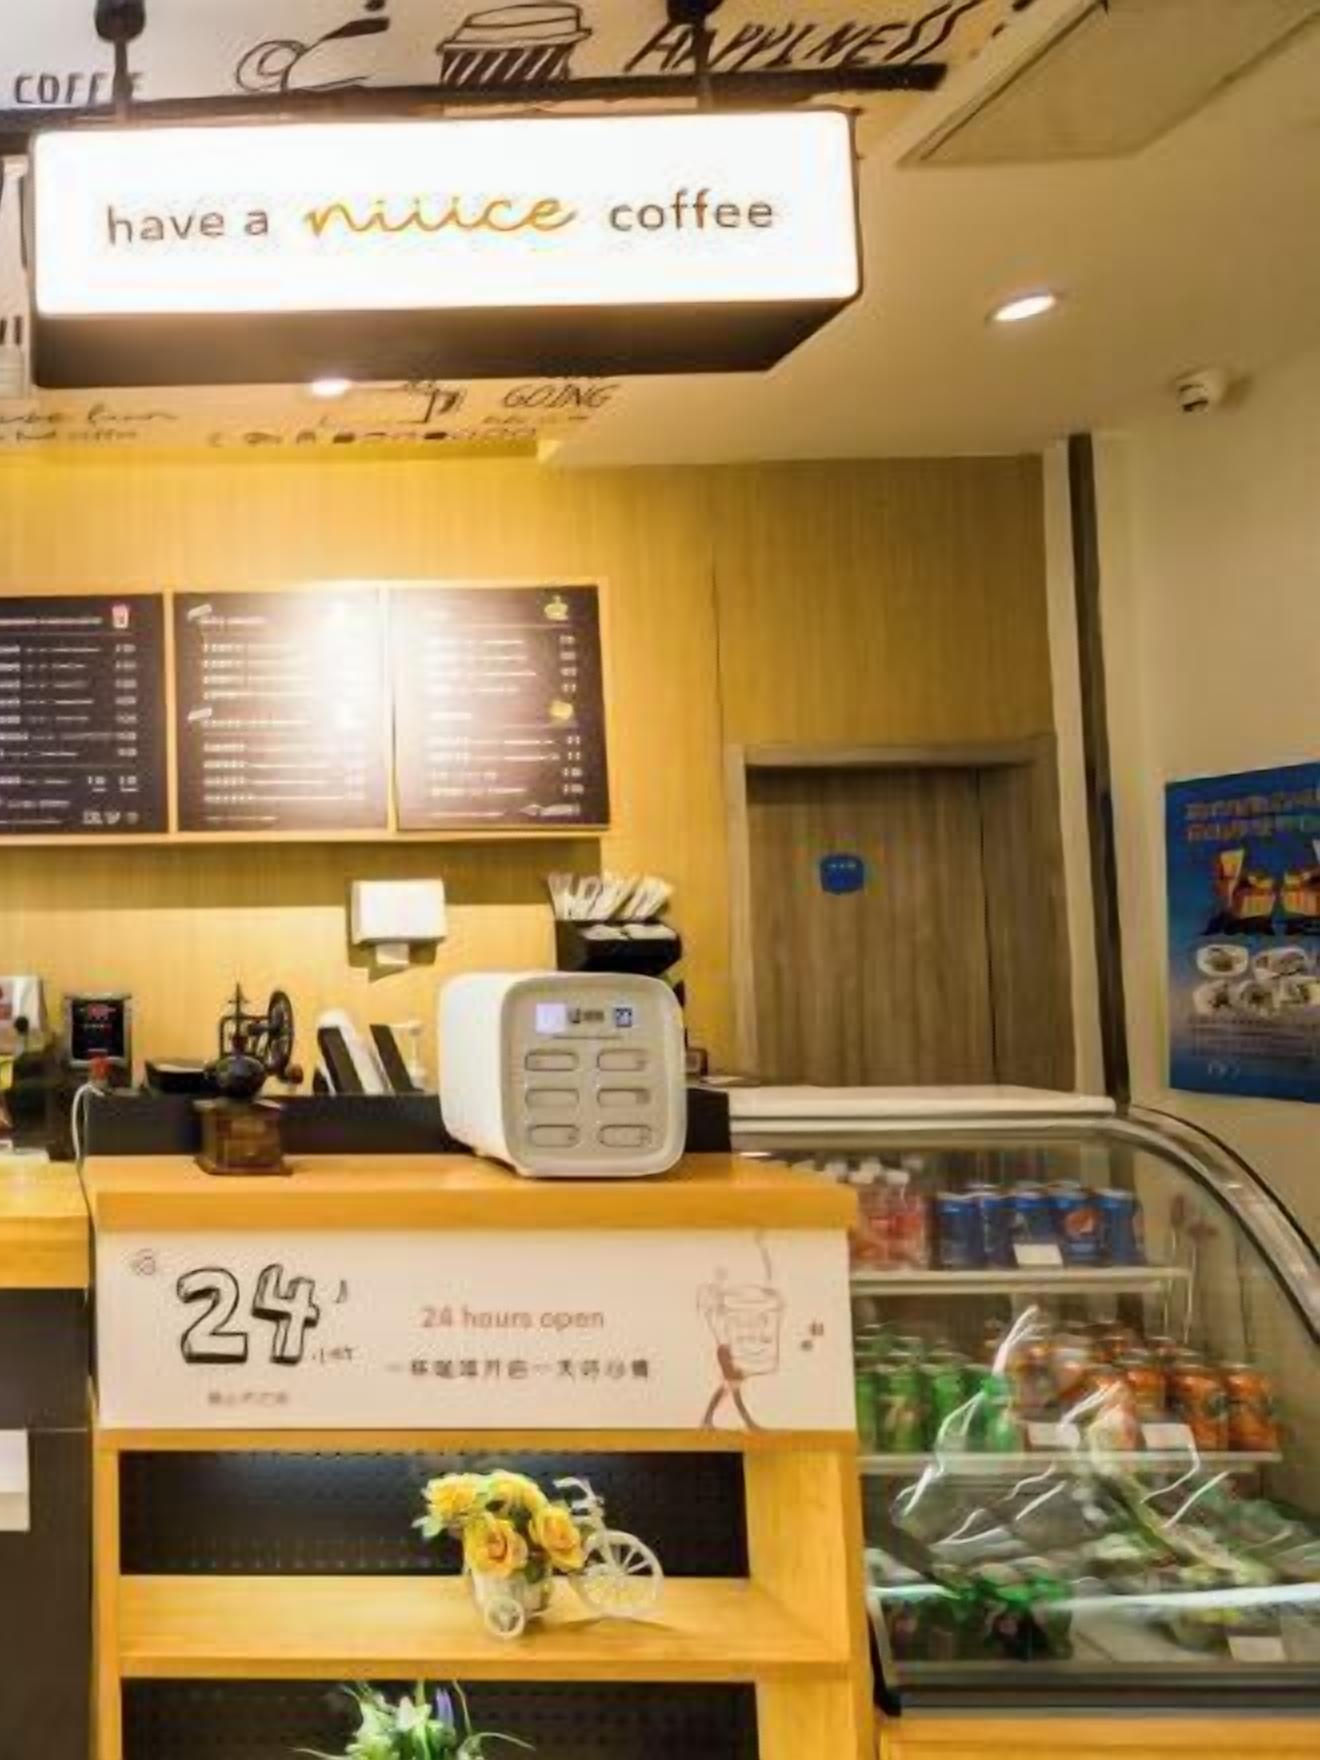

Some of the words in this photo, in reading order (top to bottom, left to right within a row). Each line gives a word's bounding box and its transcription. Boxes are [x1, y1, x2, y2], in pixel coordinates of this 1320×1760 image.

[107, 204, 225, 245] have
[243, 208, 269, 236] a
[609, 187, 773, 233] coffee
[503, 384, 621, 409] GOING
[176, 1263, 320, 1366] 24
[422, 1305, 454, 1329] 24
[461, 1304, 533, 1330] hours
[539, 1310, 606, 1332] open
